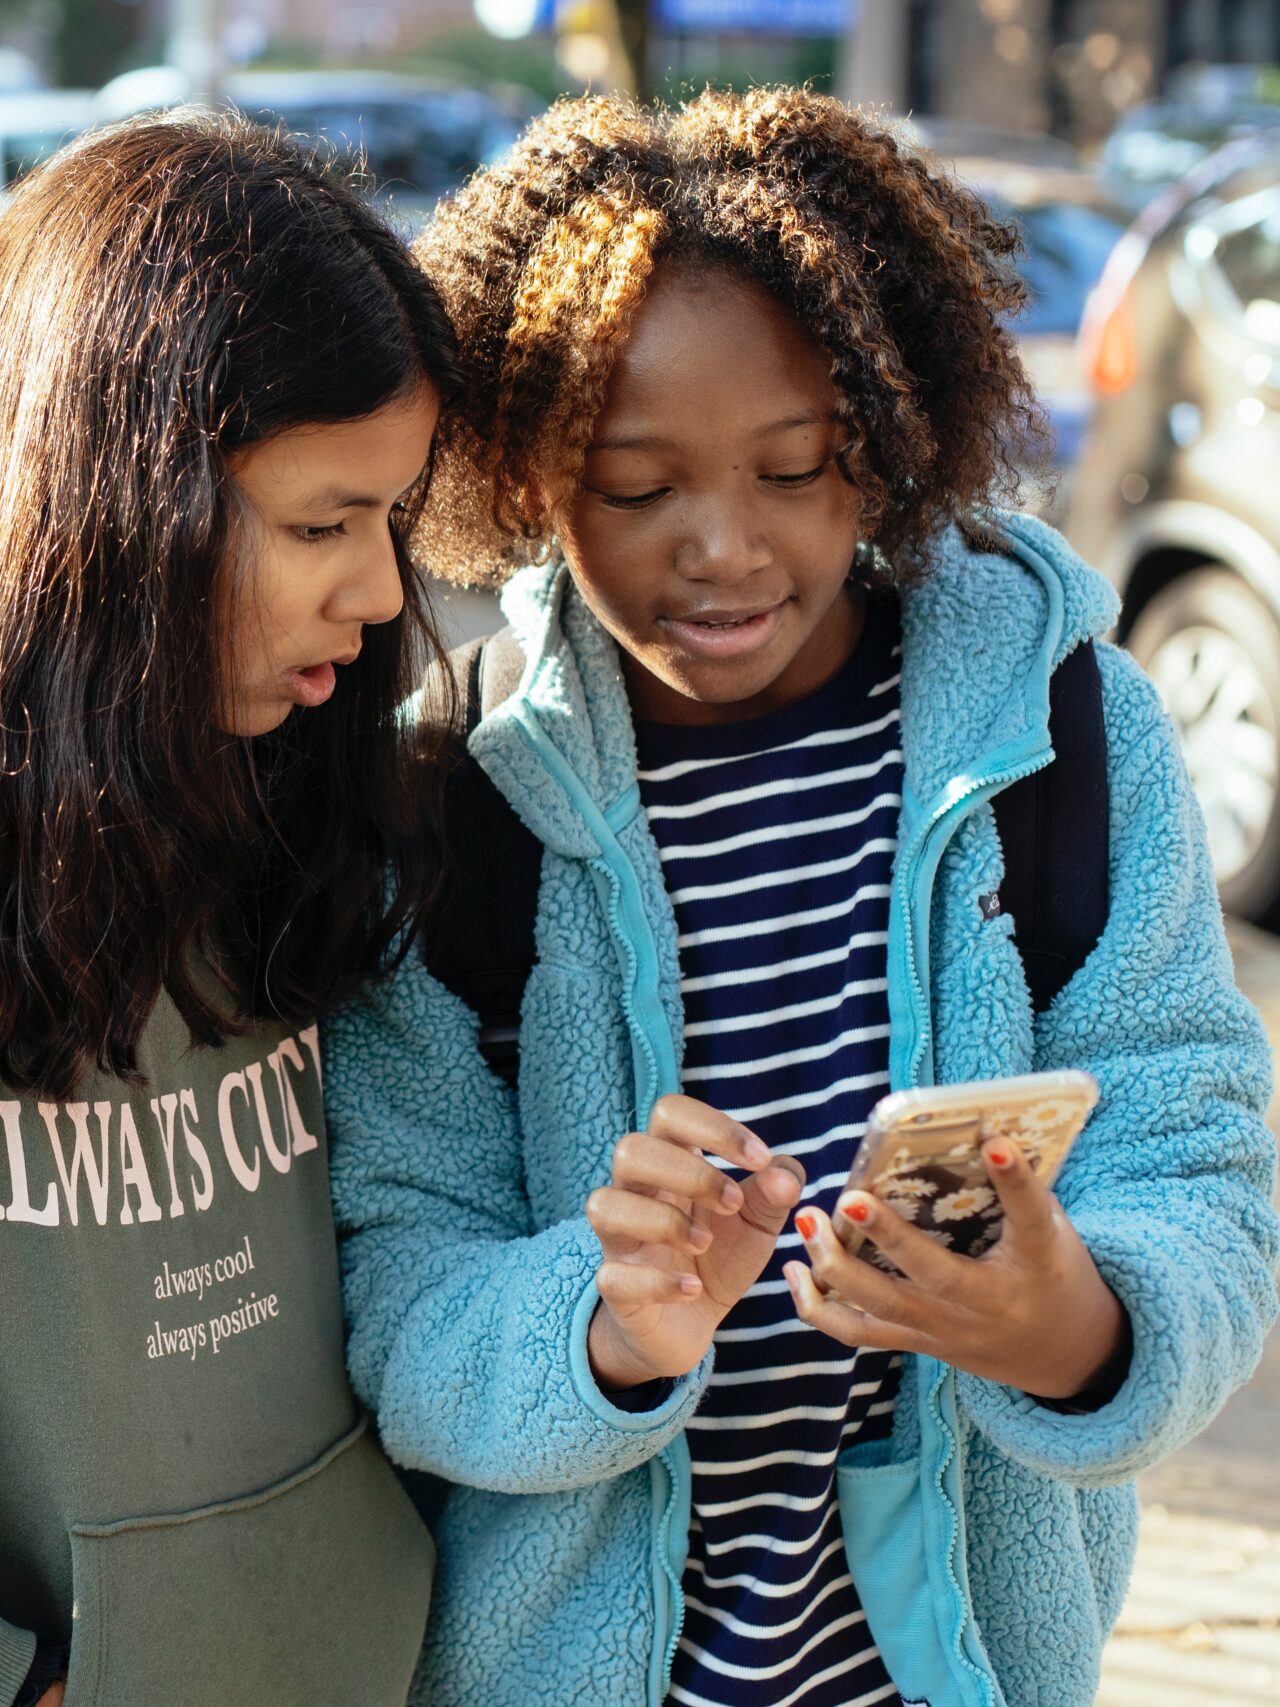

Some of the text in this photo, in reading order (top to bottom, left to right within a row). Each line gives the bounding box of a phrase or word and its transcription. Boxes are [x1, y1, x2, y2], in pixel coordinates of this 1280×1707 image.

[154, 1236, 255, 1300] always cool
[147, 1292, 279, 1360] always positive
